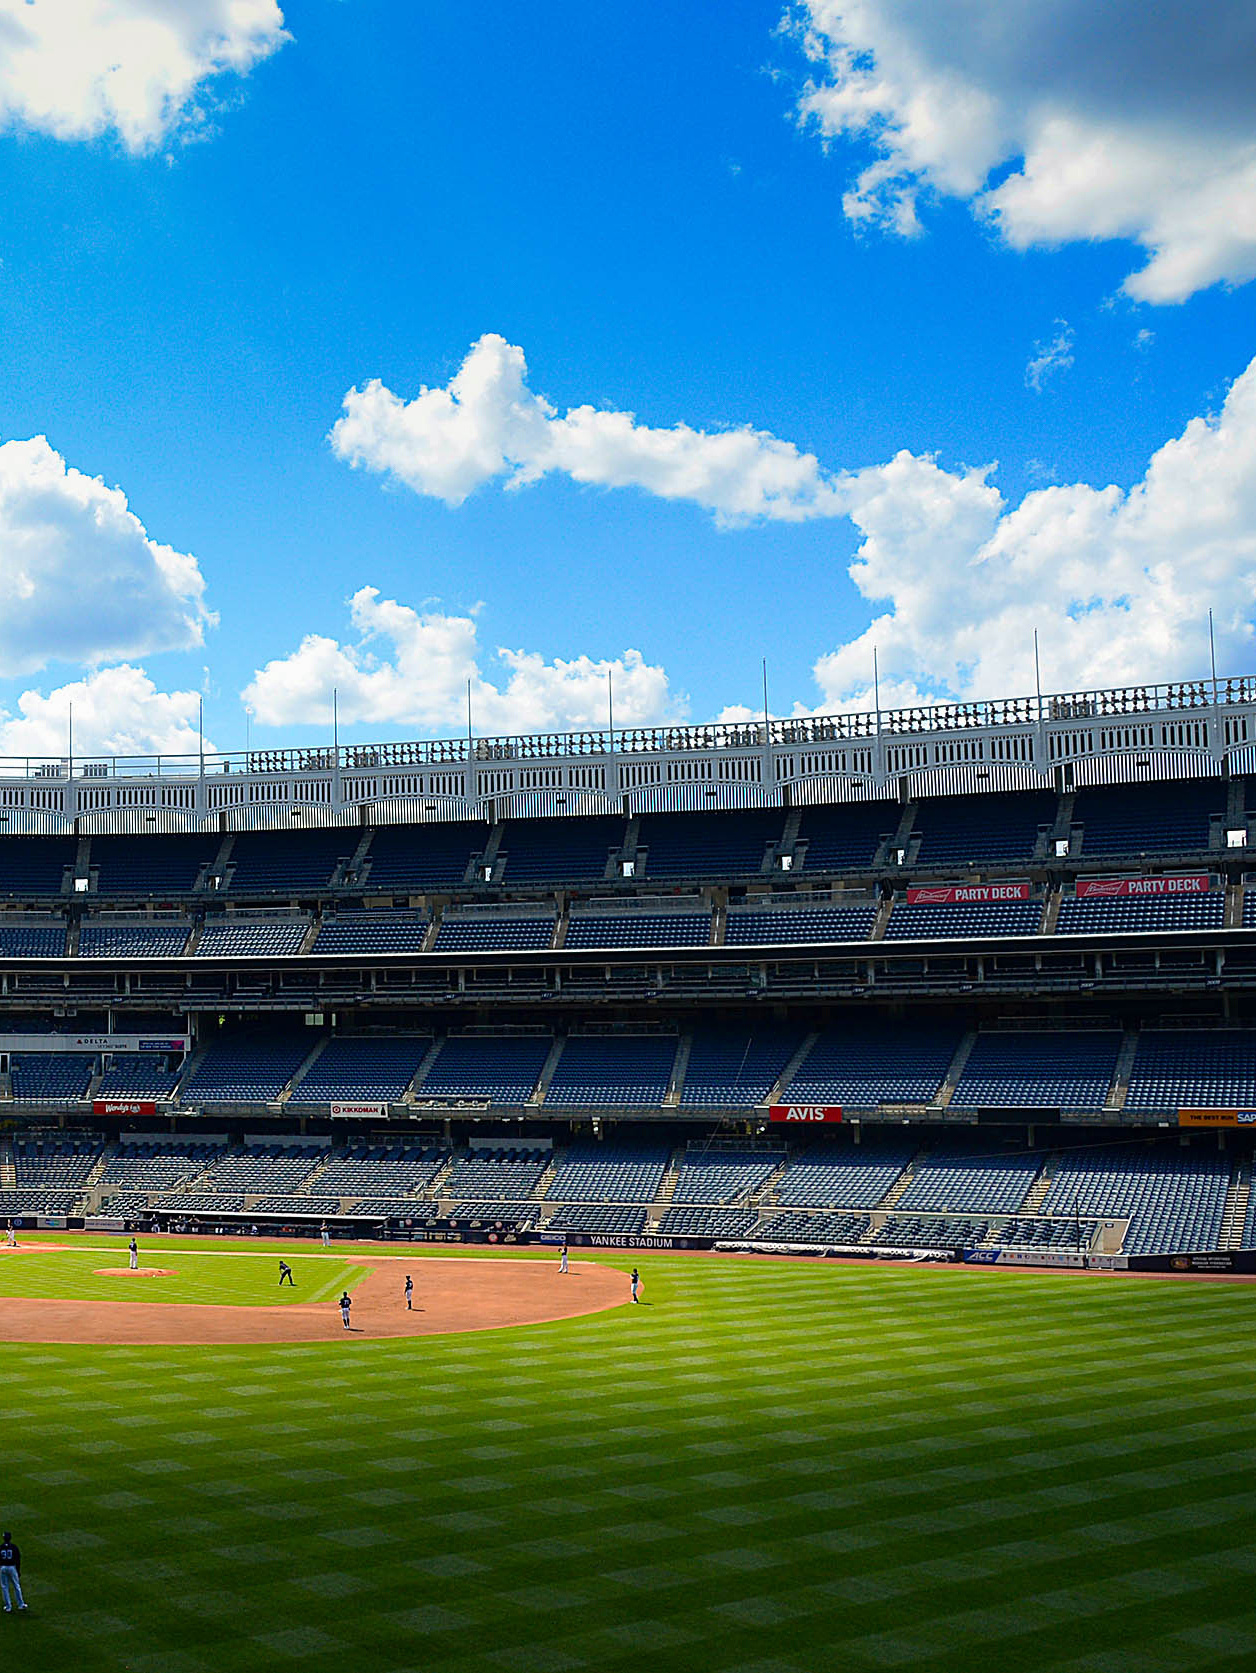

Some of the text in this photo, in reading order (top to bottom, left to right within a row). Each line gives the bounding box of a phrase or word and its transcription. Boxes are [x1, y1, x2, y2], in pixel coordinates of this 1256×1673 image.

[1128, 880, 1165, 893] PARTY
[1168, 878, 1201, 891] DECK
[955, 887, 989, 900] PARTY
[992, 886, 1022, 899] DECK
[786, 1107, 825, 1121] AVIS
[1237, 1113, 1256, 1122] SAP
[590, 1236, 673, 1248] YANKEE STADIUM
[969, 1252, 994, 1260] ACC
